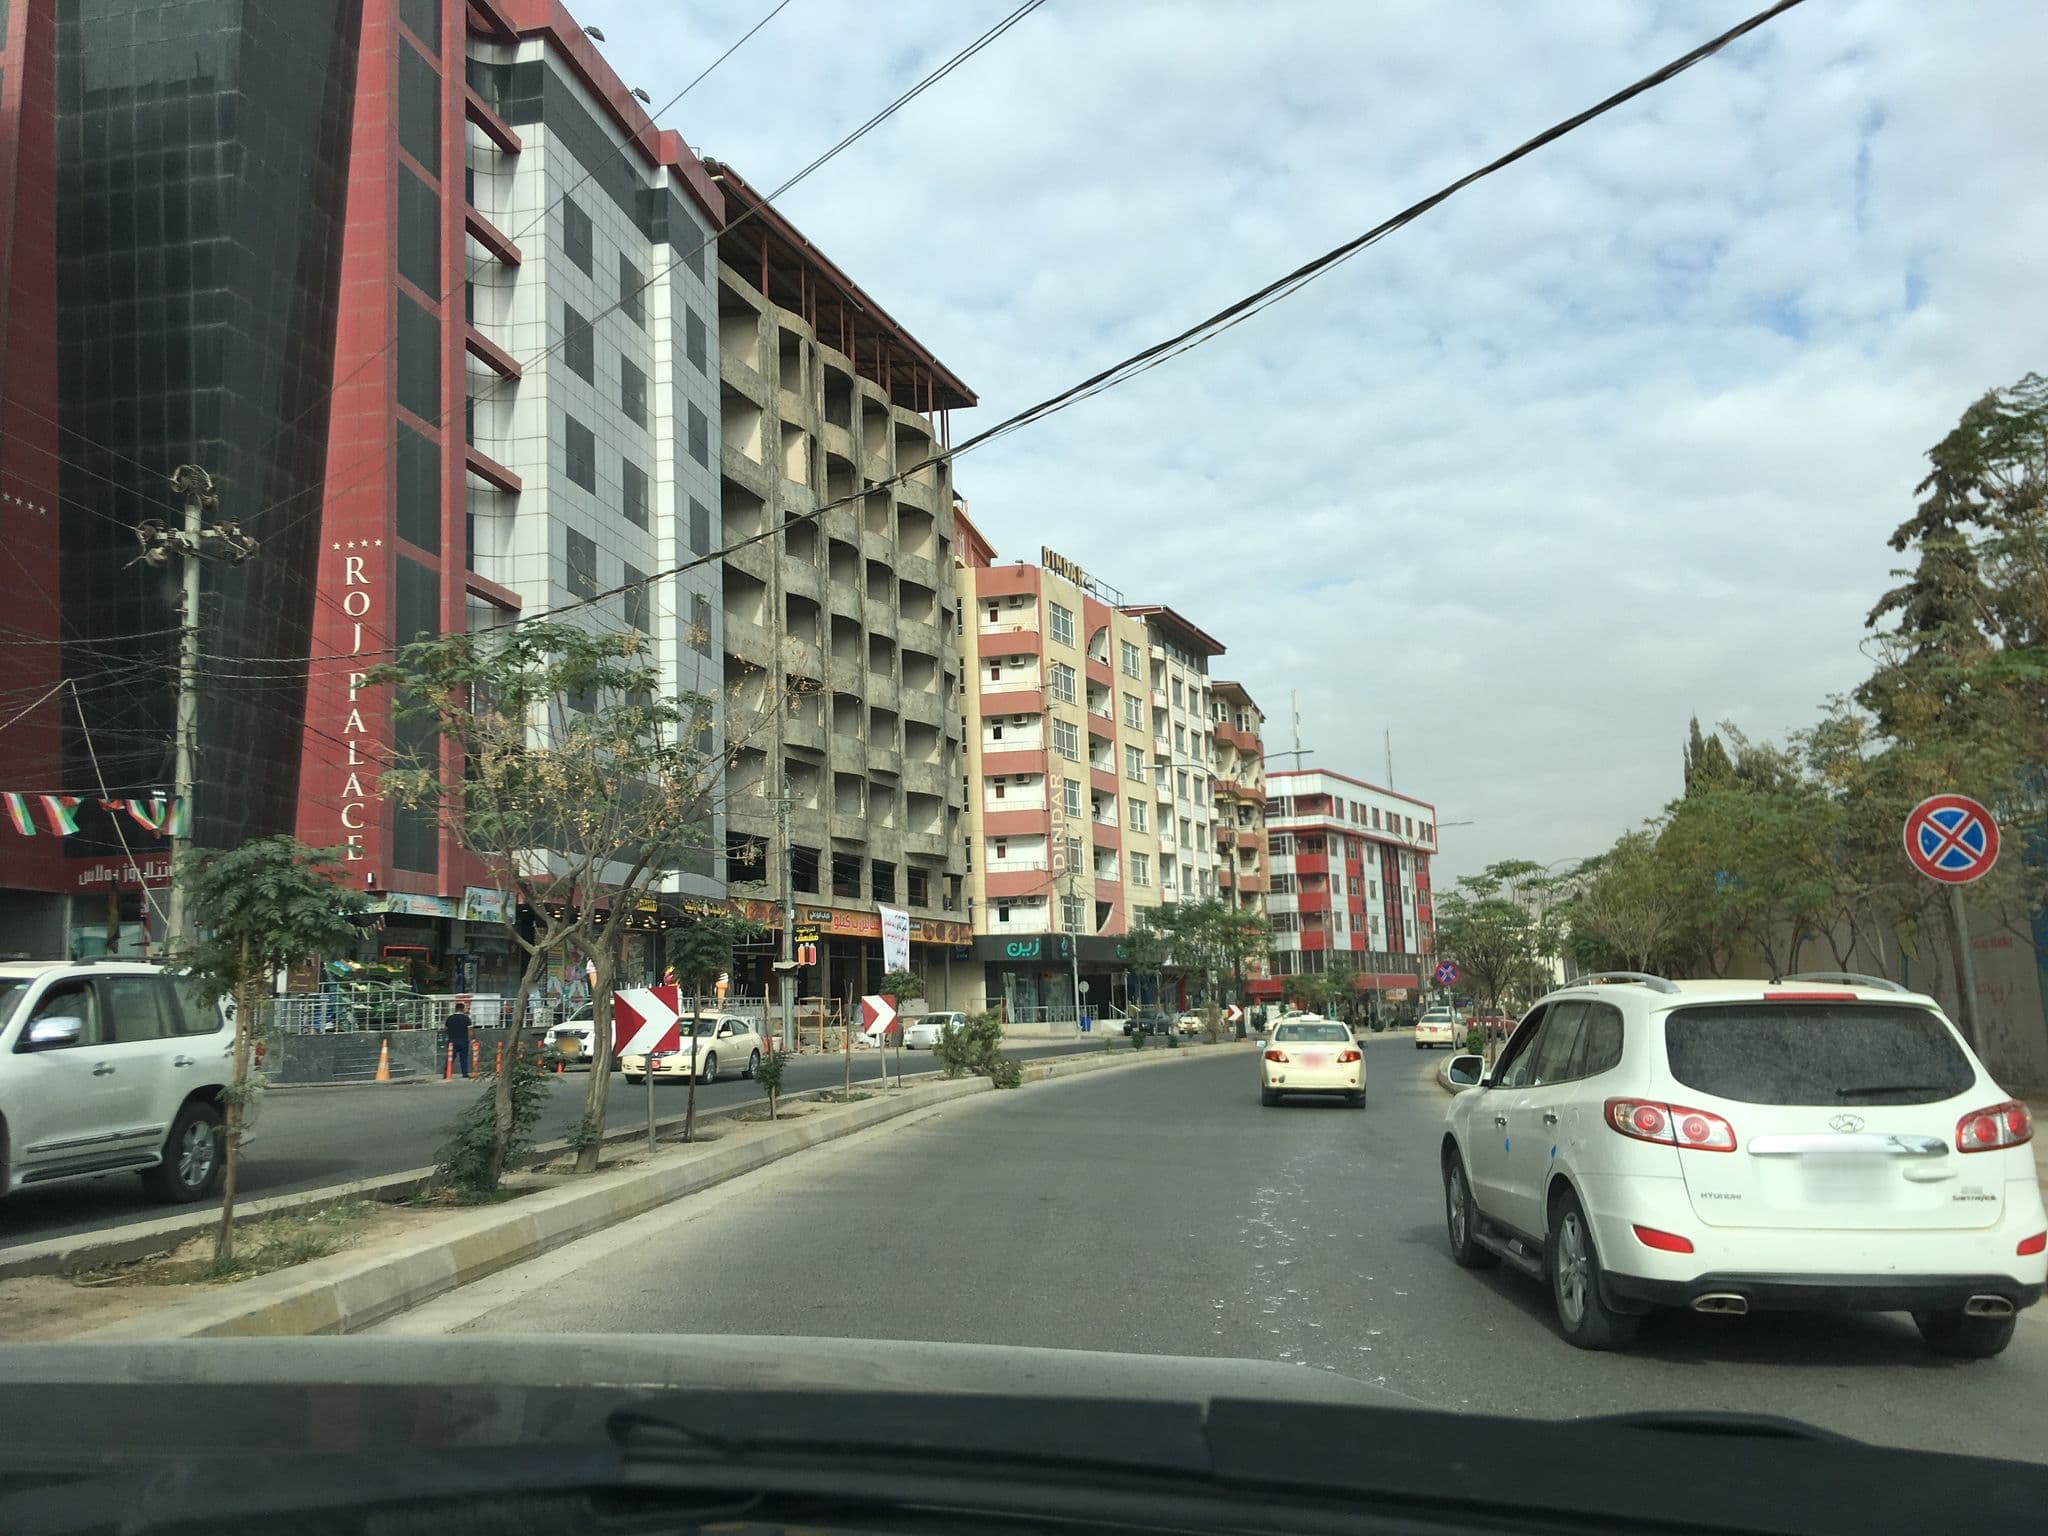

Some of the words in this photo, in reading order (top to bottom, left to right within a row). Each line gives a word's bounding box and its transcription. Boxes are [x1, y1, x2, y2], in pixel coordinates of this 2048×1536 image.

[343, 556, 371, 656] ROJ
[340, 672, 368, 861] PALACE
[1049, 773, 1066, 870] DINDAR
